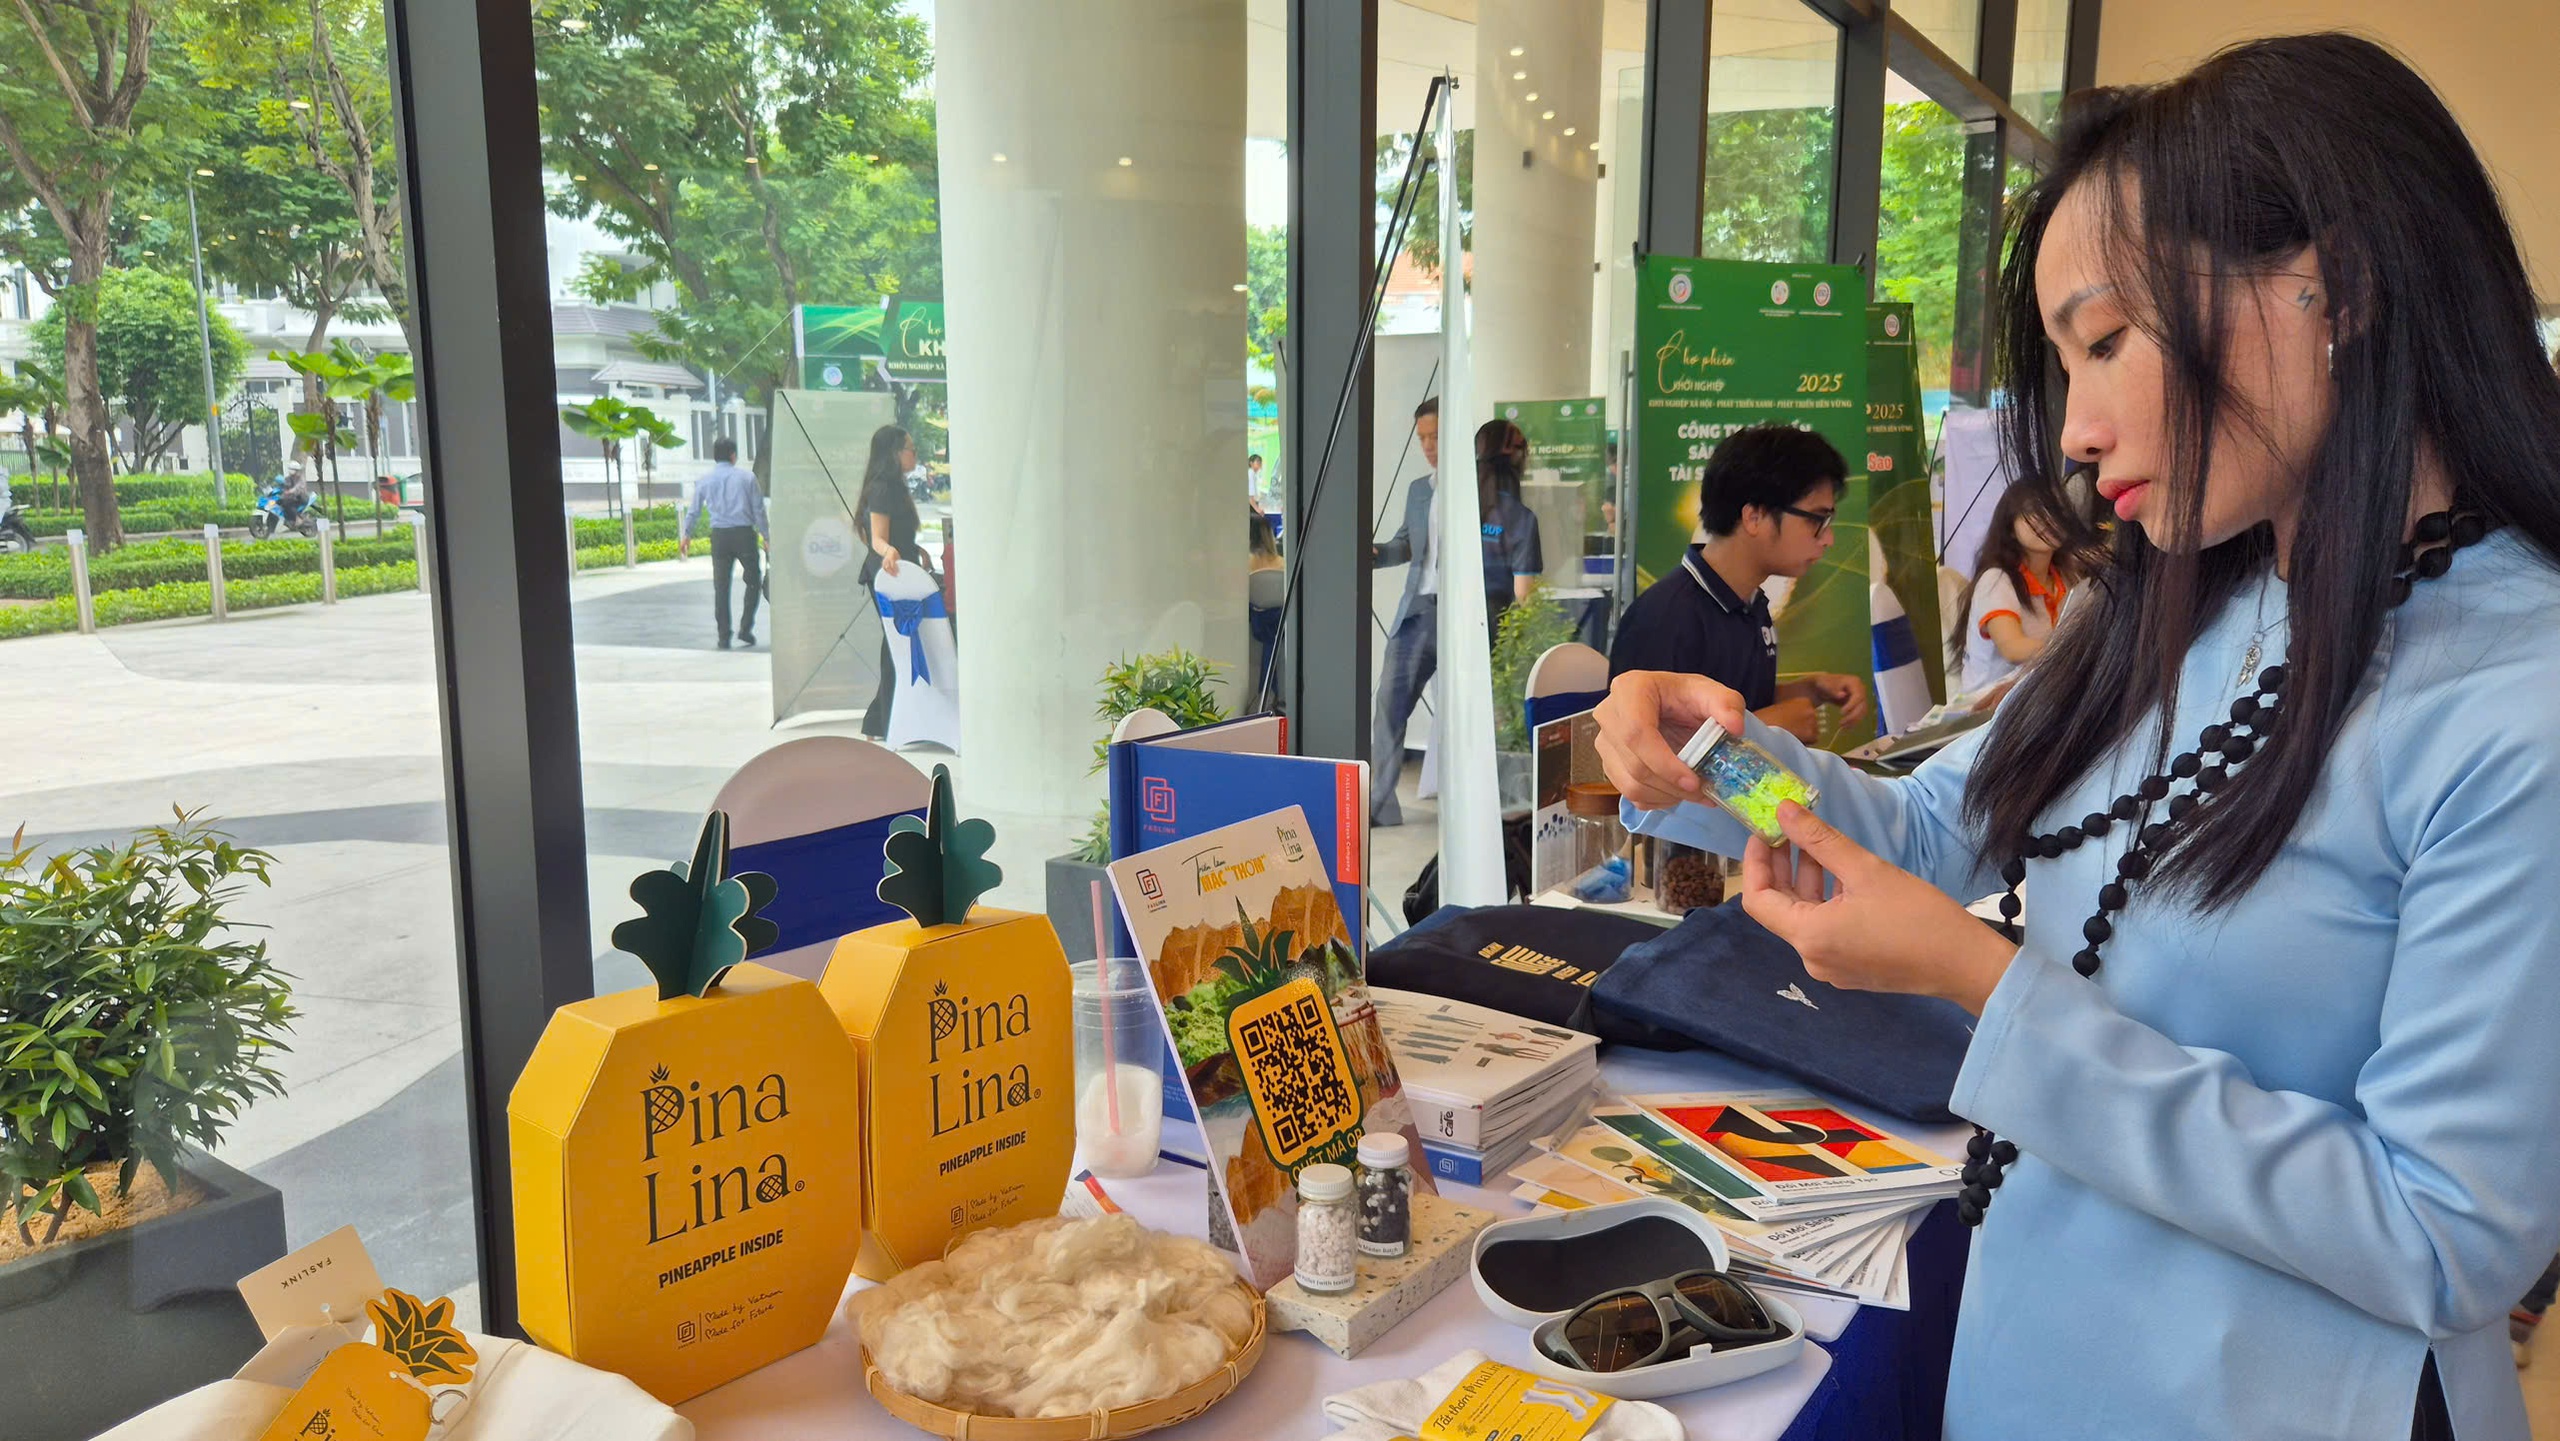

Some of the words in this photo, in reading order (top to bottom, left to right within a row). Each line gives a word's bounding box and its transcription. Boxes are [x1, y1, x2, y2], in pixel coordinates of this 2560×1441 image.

[1797, 373, 1843, 392] 2025
[1872, 403, 1905, 420] 2025
[1677, 420, 1721, 439] CÔNG
[1669, 463, 1691, 481] TÀI
[1867, 452, 1894, 472] Sao
[1277, 826, 1298, 843] Pina
[1282, 841, 1302, 856] Lina
[927, 994, 1031, 1064] Pina
[640, 1074, 791, 1162] Pina
[939, 1142, 994, 1176] PINEAPPLE
[996, 1131, 1027, 1152] INSIDE
[1767, 1231, 1789, 1241] Đổi
[658, 1246, 737, 1289] PINEAPPLE
[740, 1229, 784, 1257] INSIDE
[282, 1257, 332, 1289] FASLINK
[705, 1309, 729, 1323] Made
[732, 1303, 745, 1314] by
[705, 1327, 728, 1339] Made
[729, 1319, 745, 1330] for
